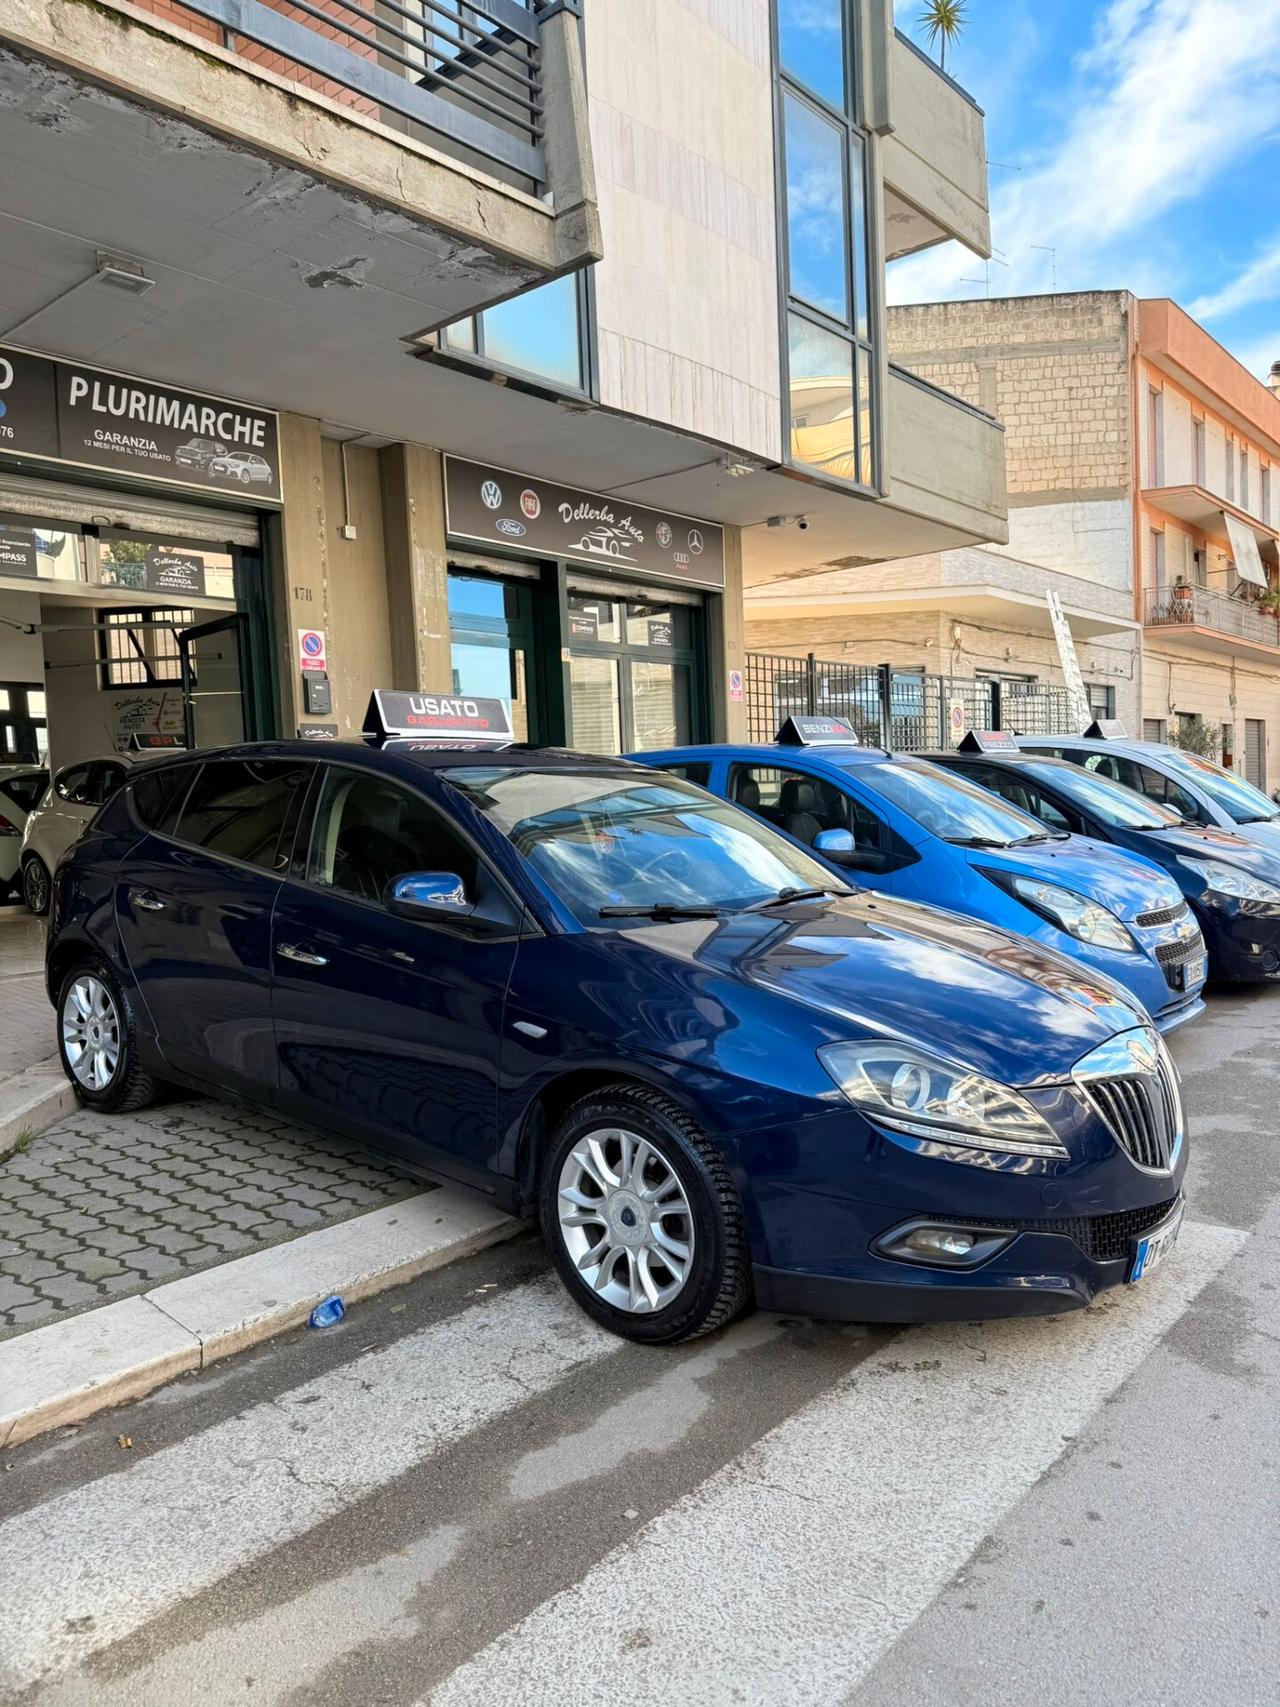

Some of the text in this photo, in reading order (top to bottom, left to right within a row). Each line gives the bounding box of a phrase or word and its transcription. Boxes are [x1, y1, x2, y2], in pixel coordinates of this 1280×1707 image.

[69, 376, 266, 447] PLURIMARCHE
[93, 440, 110, 449] MESI
[111, 443, 125, 453] PER
[134, 448, 148, 457] TUO
[149, 453, 171, 462] USATO
[94, 429, 158, 451] GARANZIA
[558, 502, 644, 542] Dellerba Auto
[409, 697, 479, 717] USATO
